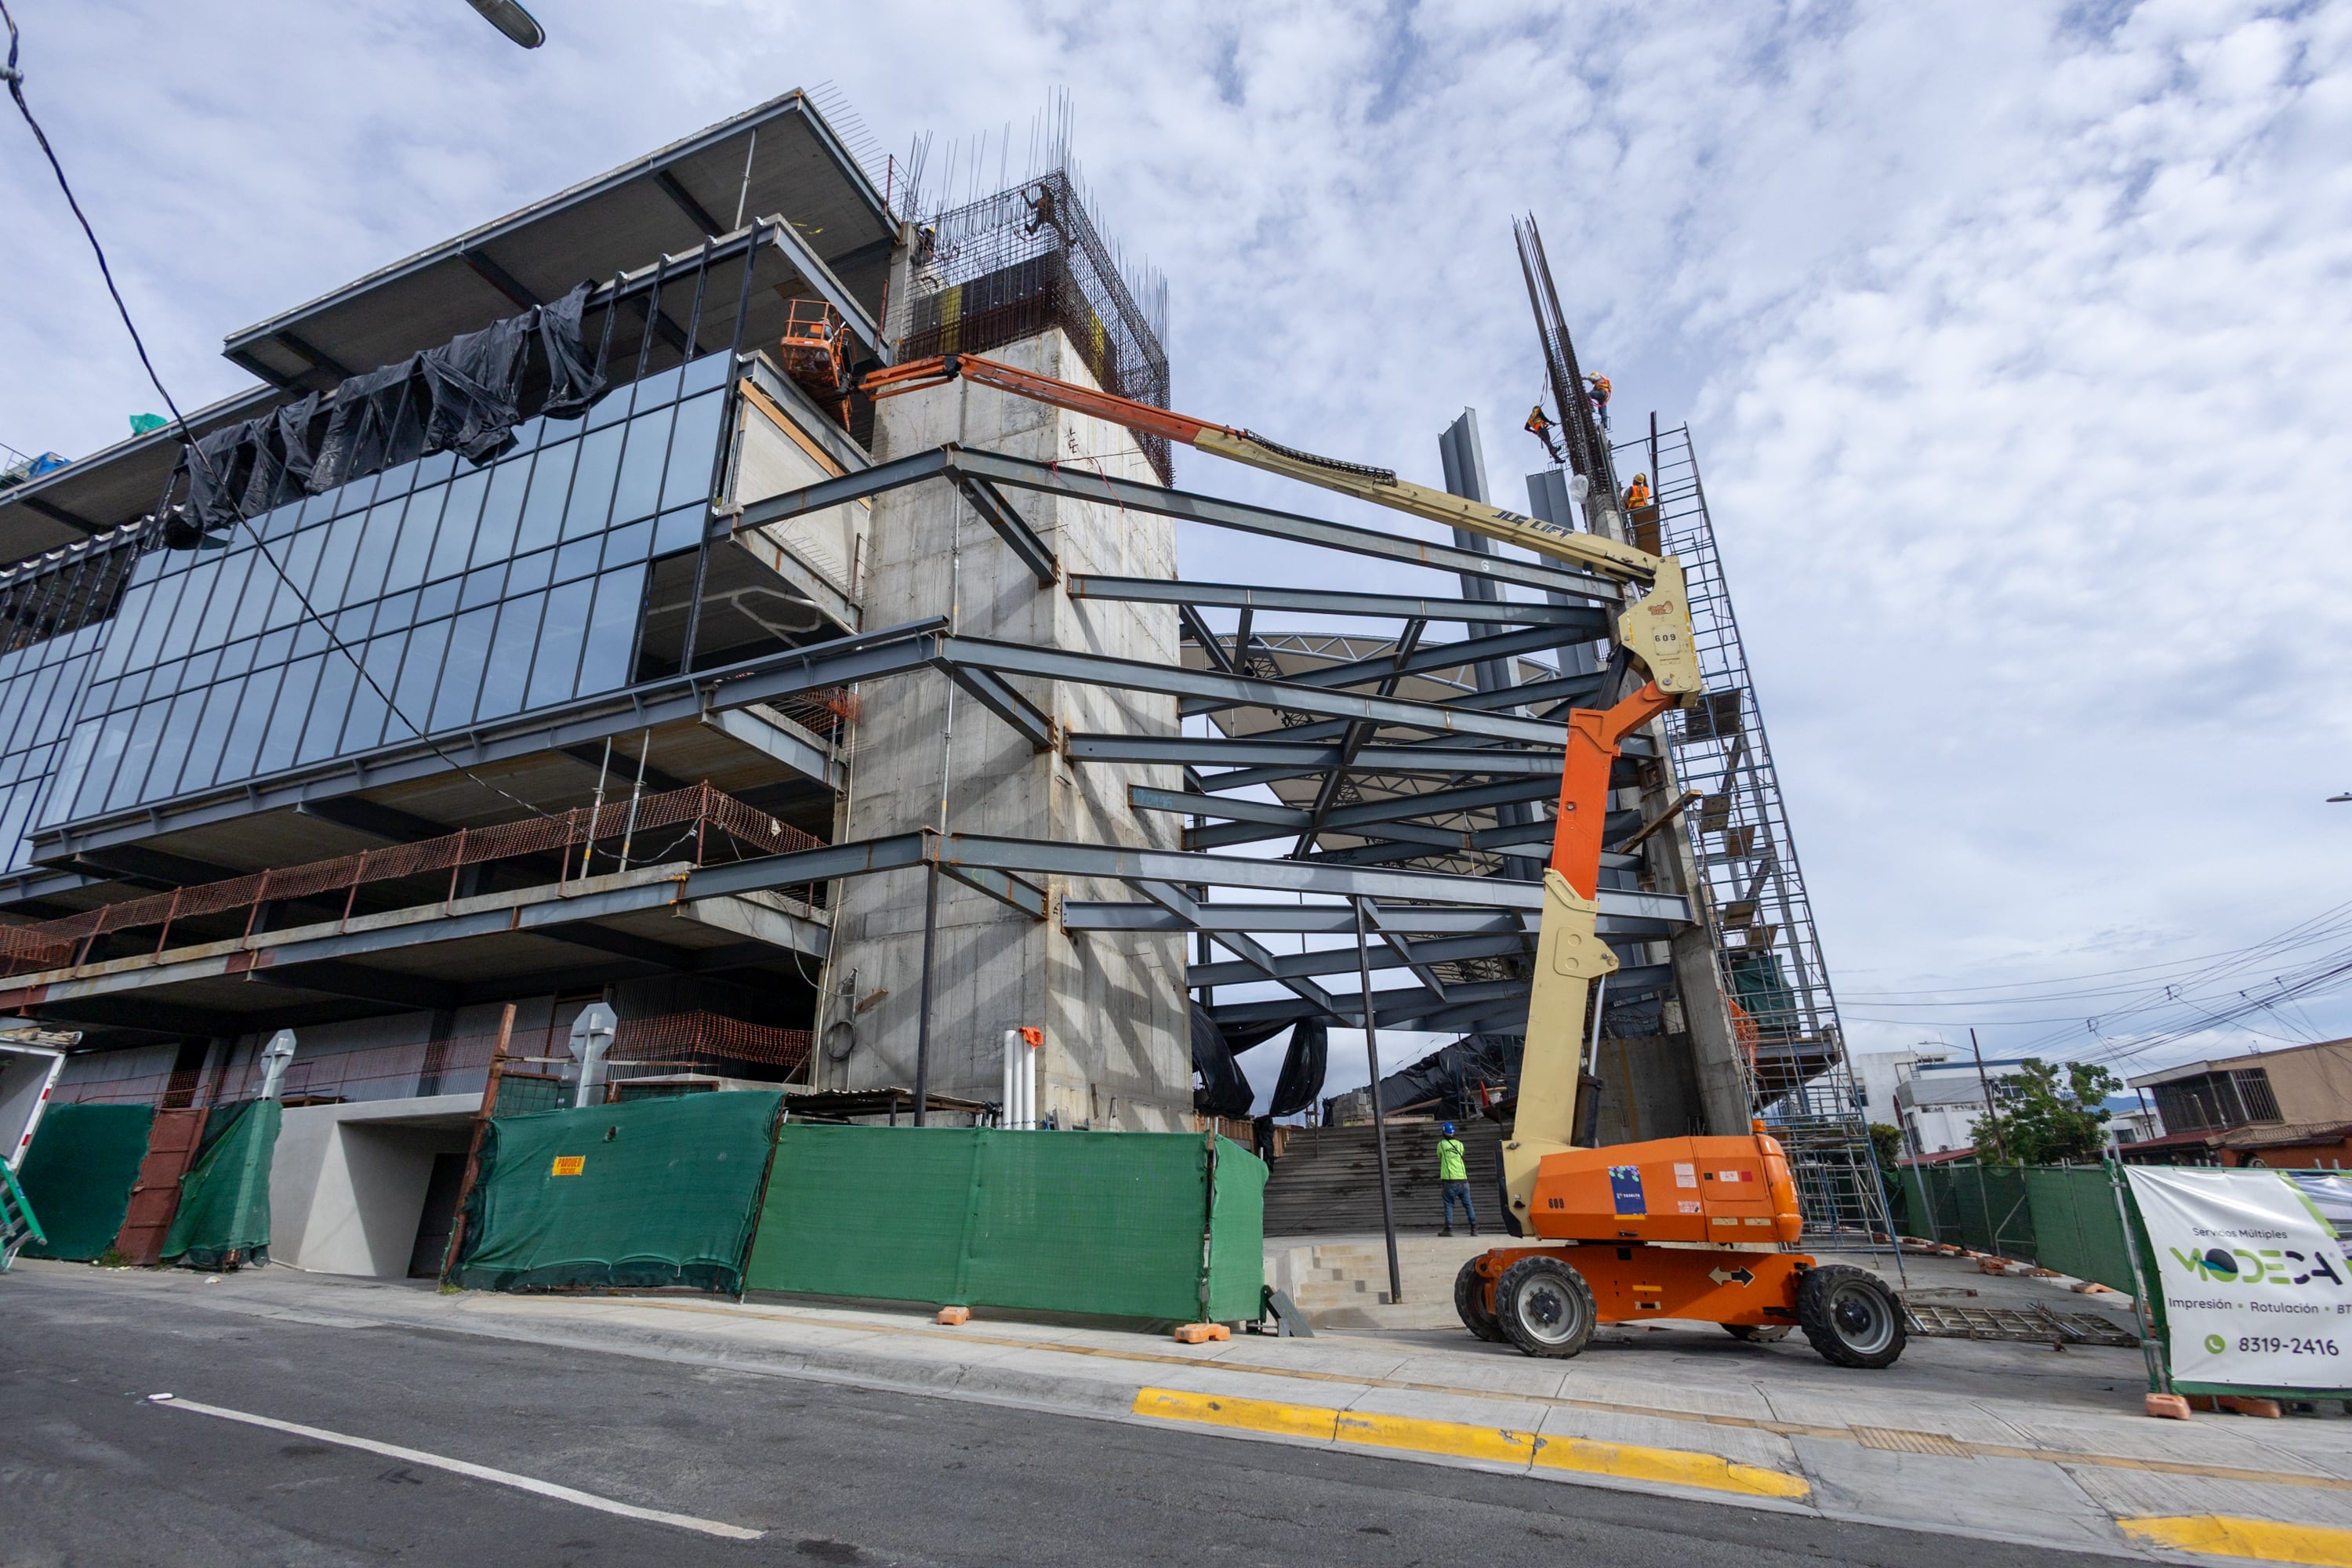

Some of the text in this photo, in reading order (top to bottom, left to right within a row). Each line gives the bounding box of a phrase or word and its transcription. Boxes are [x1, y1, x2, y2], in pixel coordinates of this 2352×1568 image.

[1492, 510, 1574, 538] JLG LIFT
[1654, 633, 1676, 642] 609
[557, 1157, 583, 1167] PARQUEO
[1548, 1198, 1564, 1209] 609
[2239, 1229, 2288, 1240] Múltiples
[2169, 1247, 2343, 1286] MODECA
[2169, 1298, 2232, 1312] Impresión
[2251, 1301, 2319, 1314] Rotulación
[2238, 1337, 2339, 1356] 8319-2416
